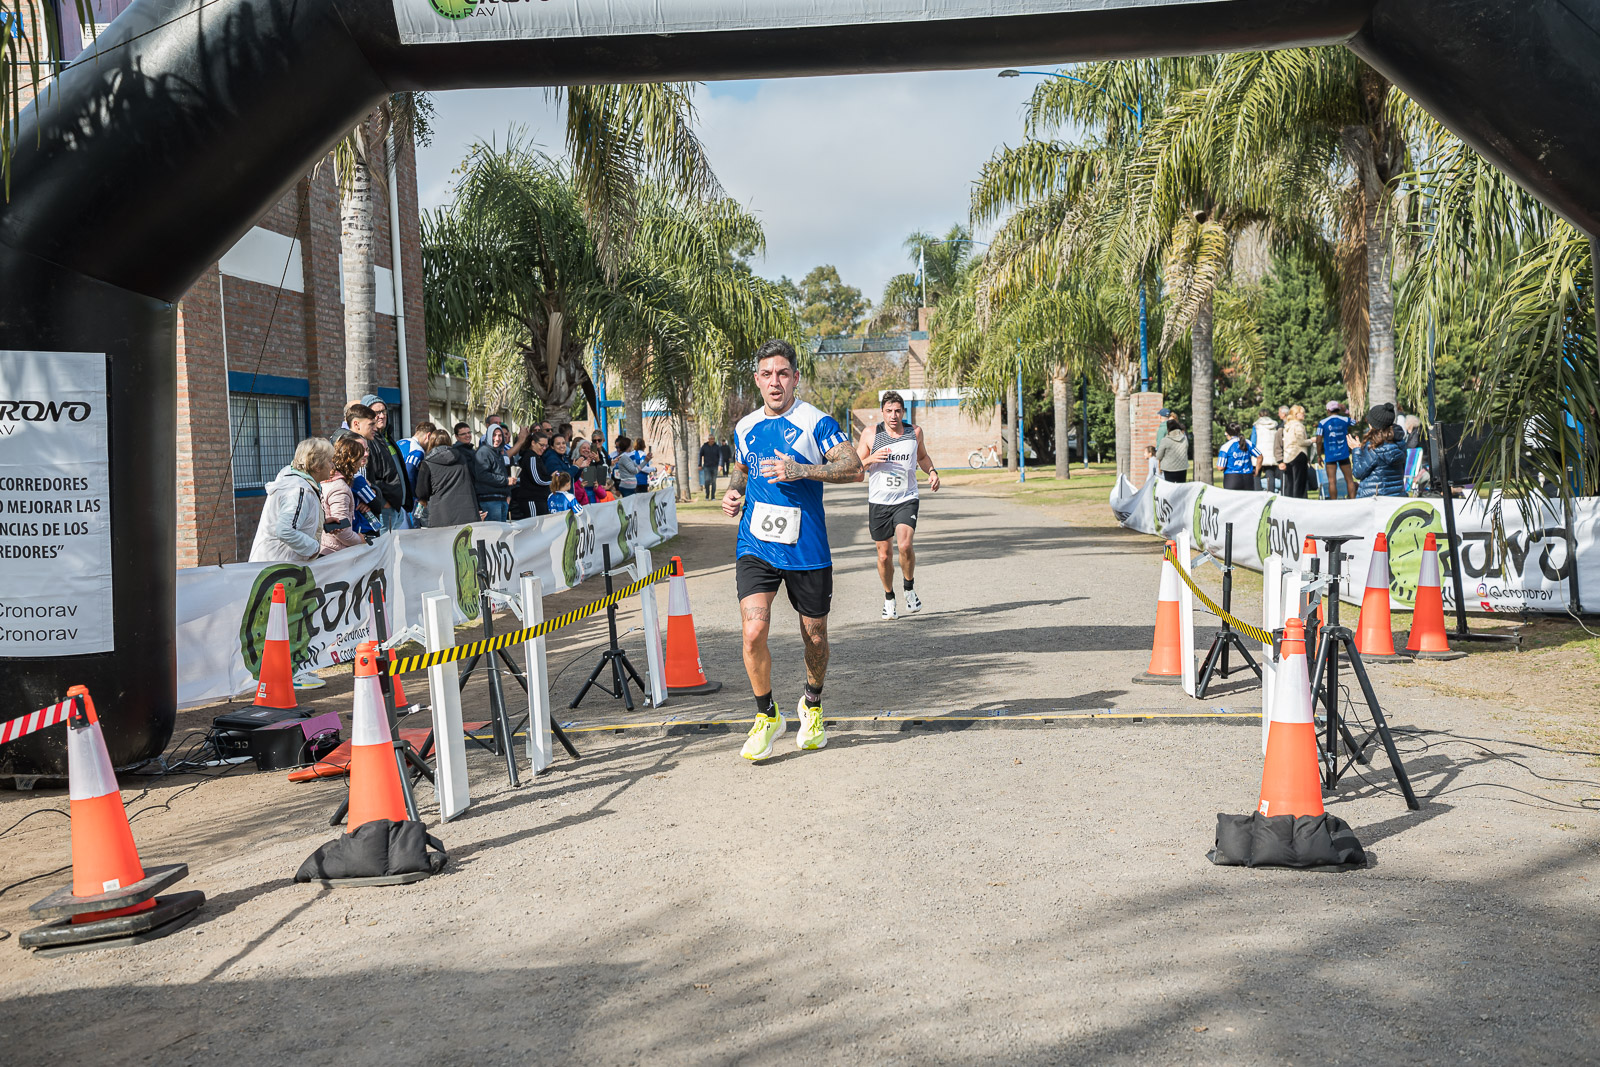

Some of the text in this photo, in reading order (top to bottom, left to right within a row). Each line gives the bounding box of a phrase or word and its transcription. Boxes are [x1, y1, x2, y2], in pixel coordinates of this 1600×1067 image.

[463, 7, 496, 17] RAV
[0, 477, 88, 491] CORREDORES
[886, 477, 902, 487] 55
[7, 500, 73, 514] MEJORAR
[76, 499, 101, 513] LAS
[0, 521, 89, 536] NCIAS DE LOS
[761, 515, 788, 534] 69
[1489, 586, 1553, 600] @cronorav
